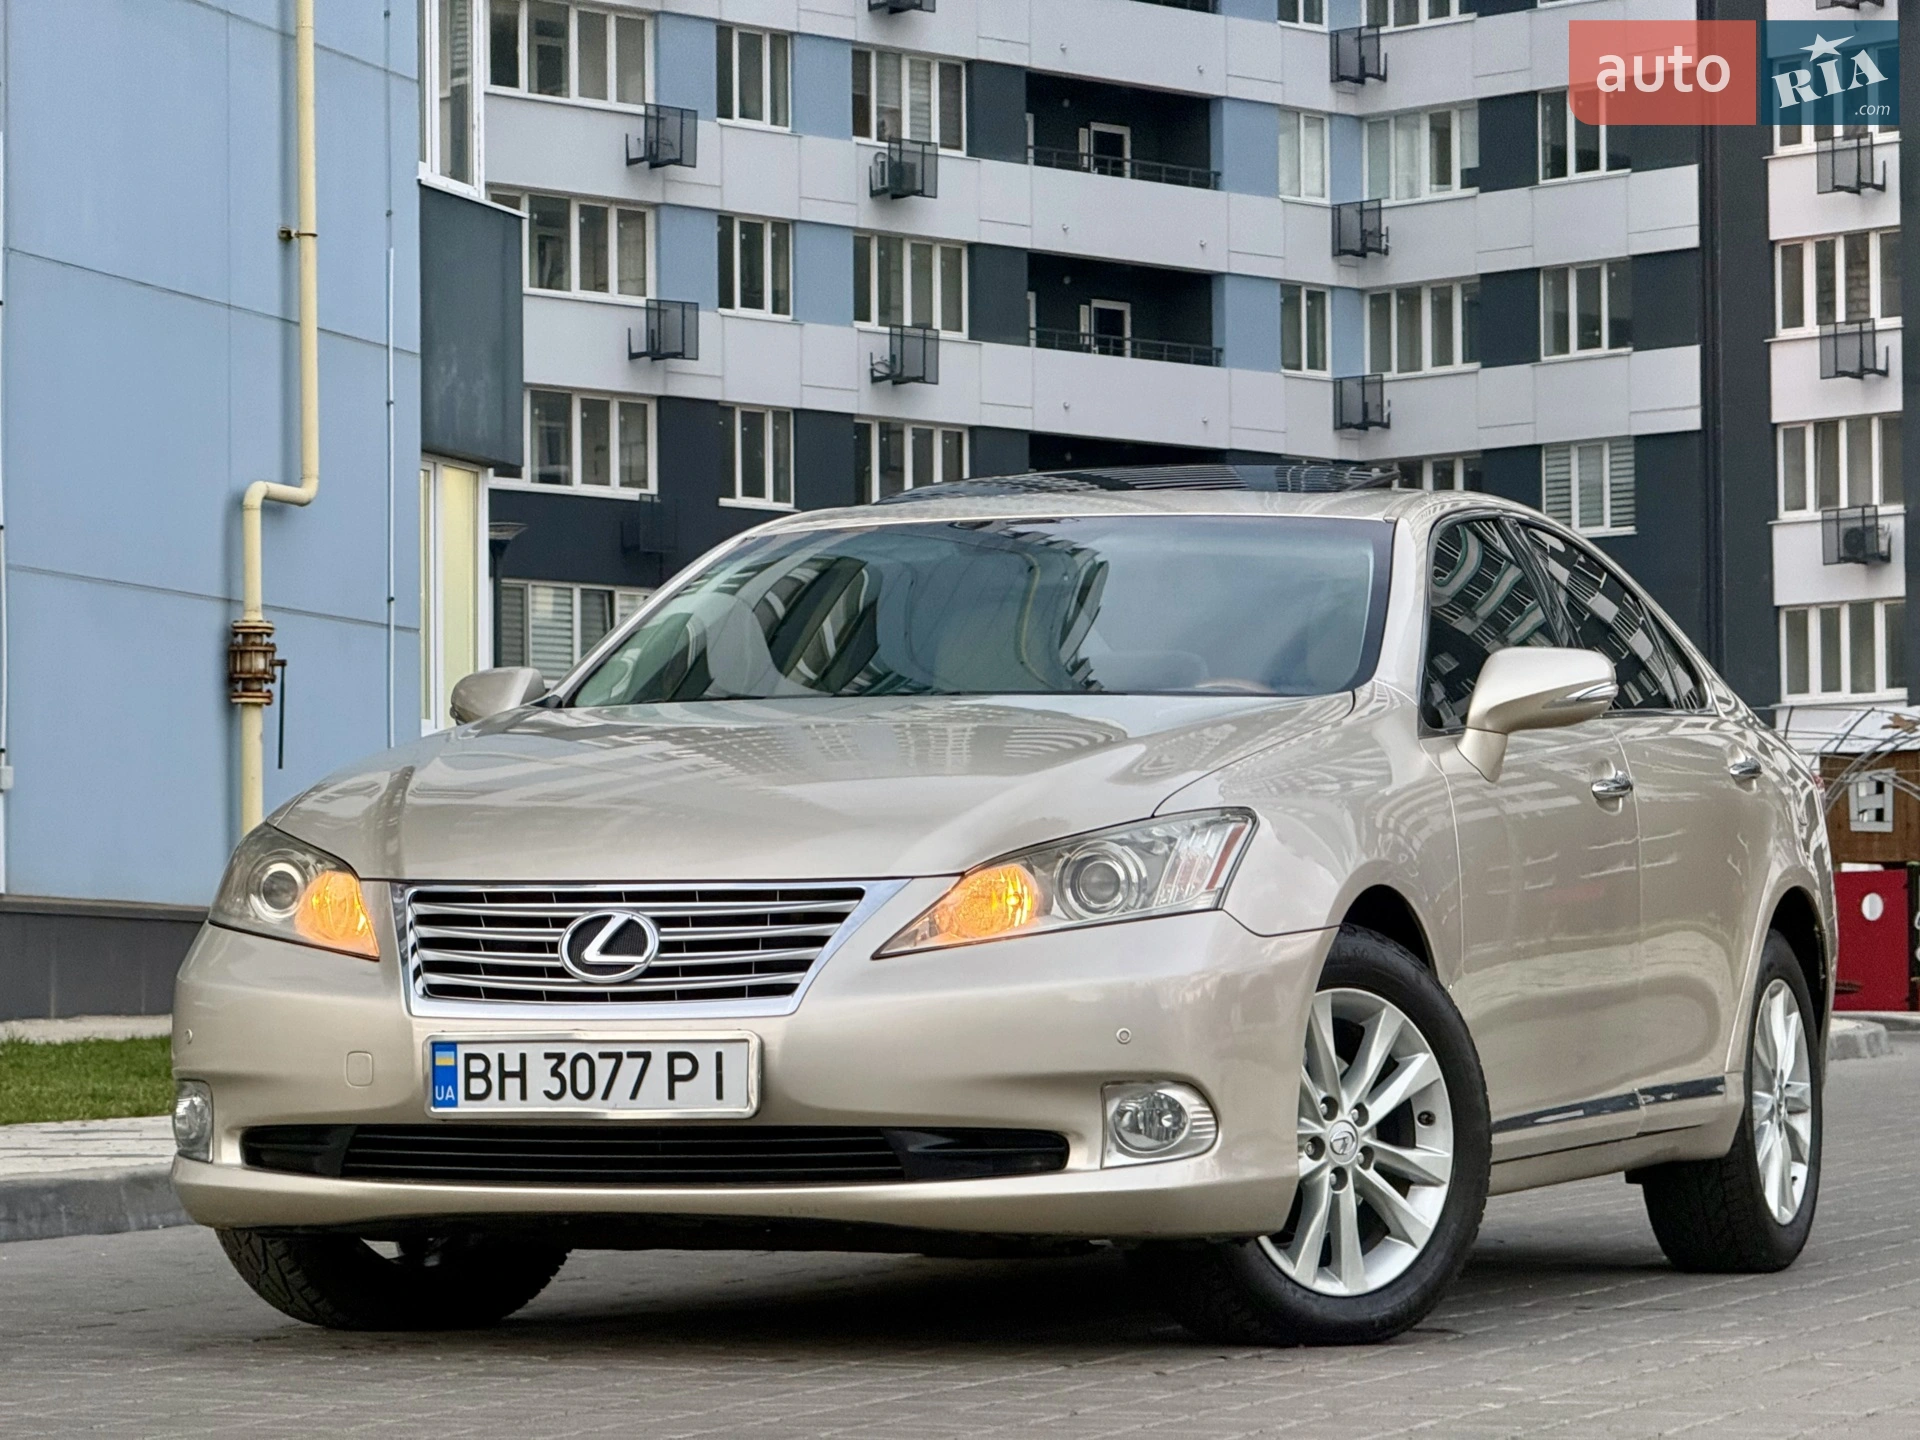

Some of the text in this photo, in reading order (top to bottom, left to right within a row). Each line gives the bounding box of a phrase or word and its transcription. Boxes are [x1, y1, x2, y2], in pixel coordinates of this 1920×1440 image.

[464, 1051, 724, 1100] BH 3077 PI
[435, 1085, 456, 1100] UA
